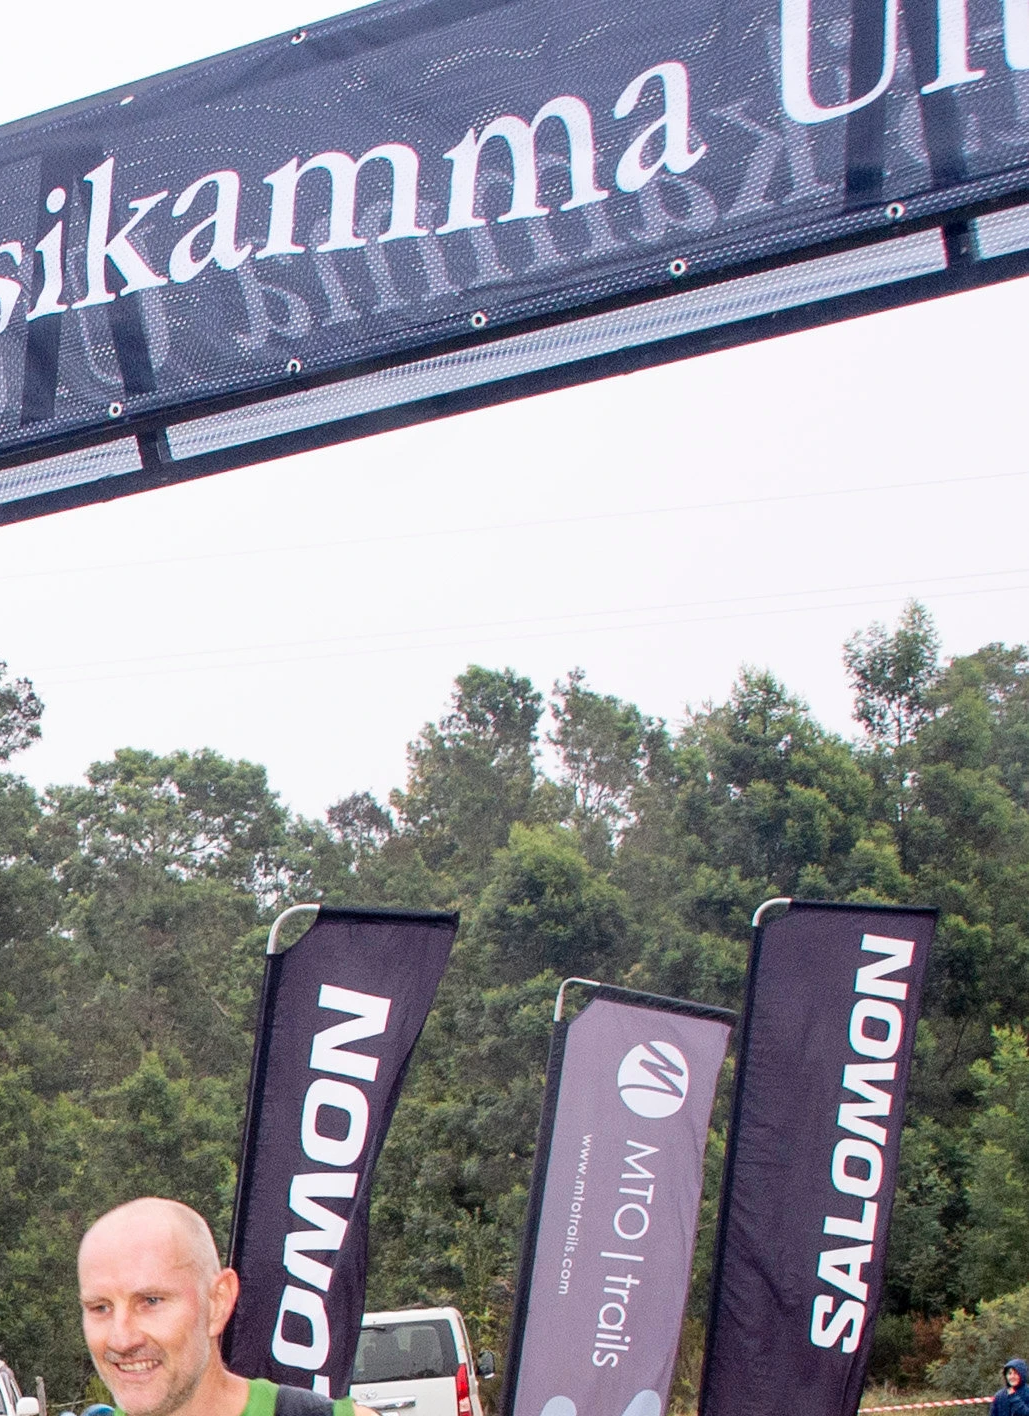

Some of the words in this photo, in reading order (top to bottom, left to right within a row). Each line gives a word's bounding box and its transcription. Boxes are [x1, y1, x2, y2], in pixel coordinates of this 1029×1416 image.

[271, 983, 392, 1398] OMON
[558, 1133, 593, 1296] www.mtotrails.com
[613, 1139, 660, 1241] MTO
[810, 932, 916, 1355] SALOMON
[591, 1273, 641, 1368] trails
